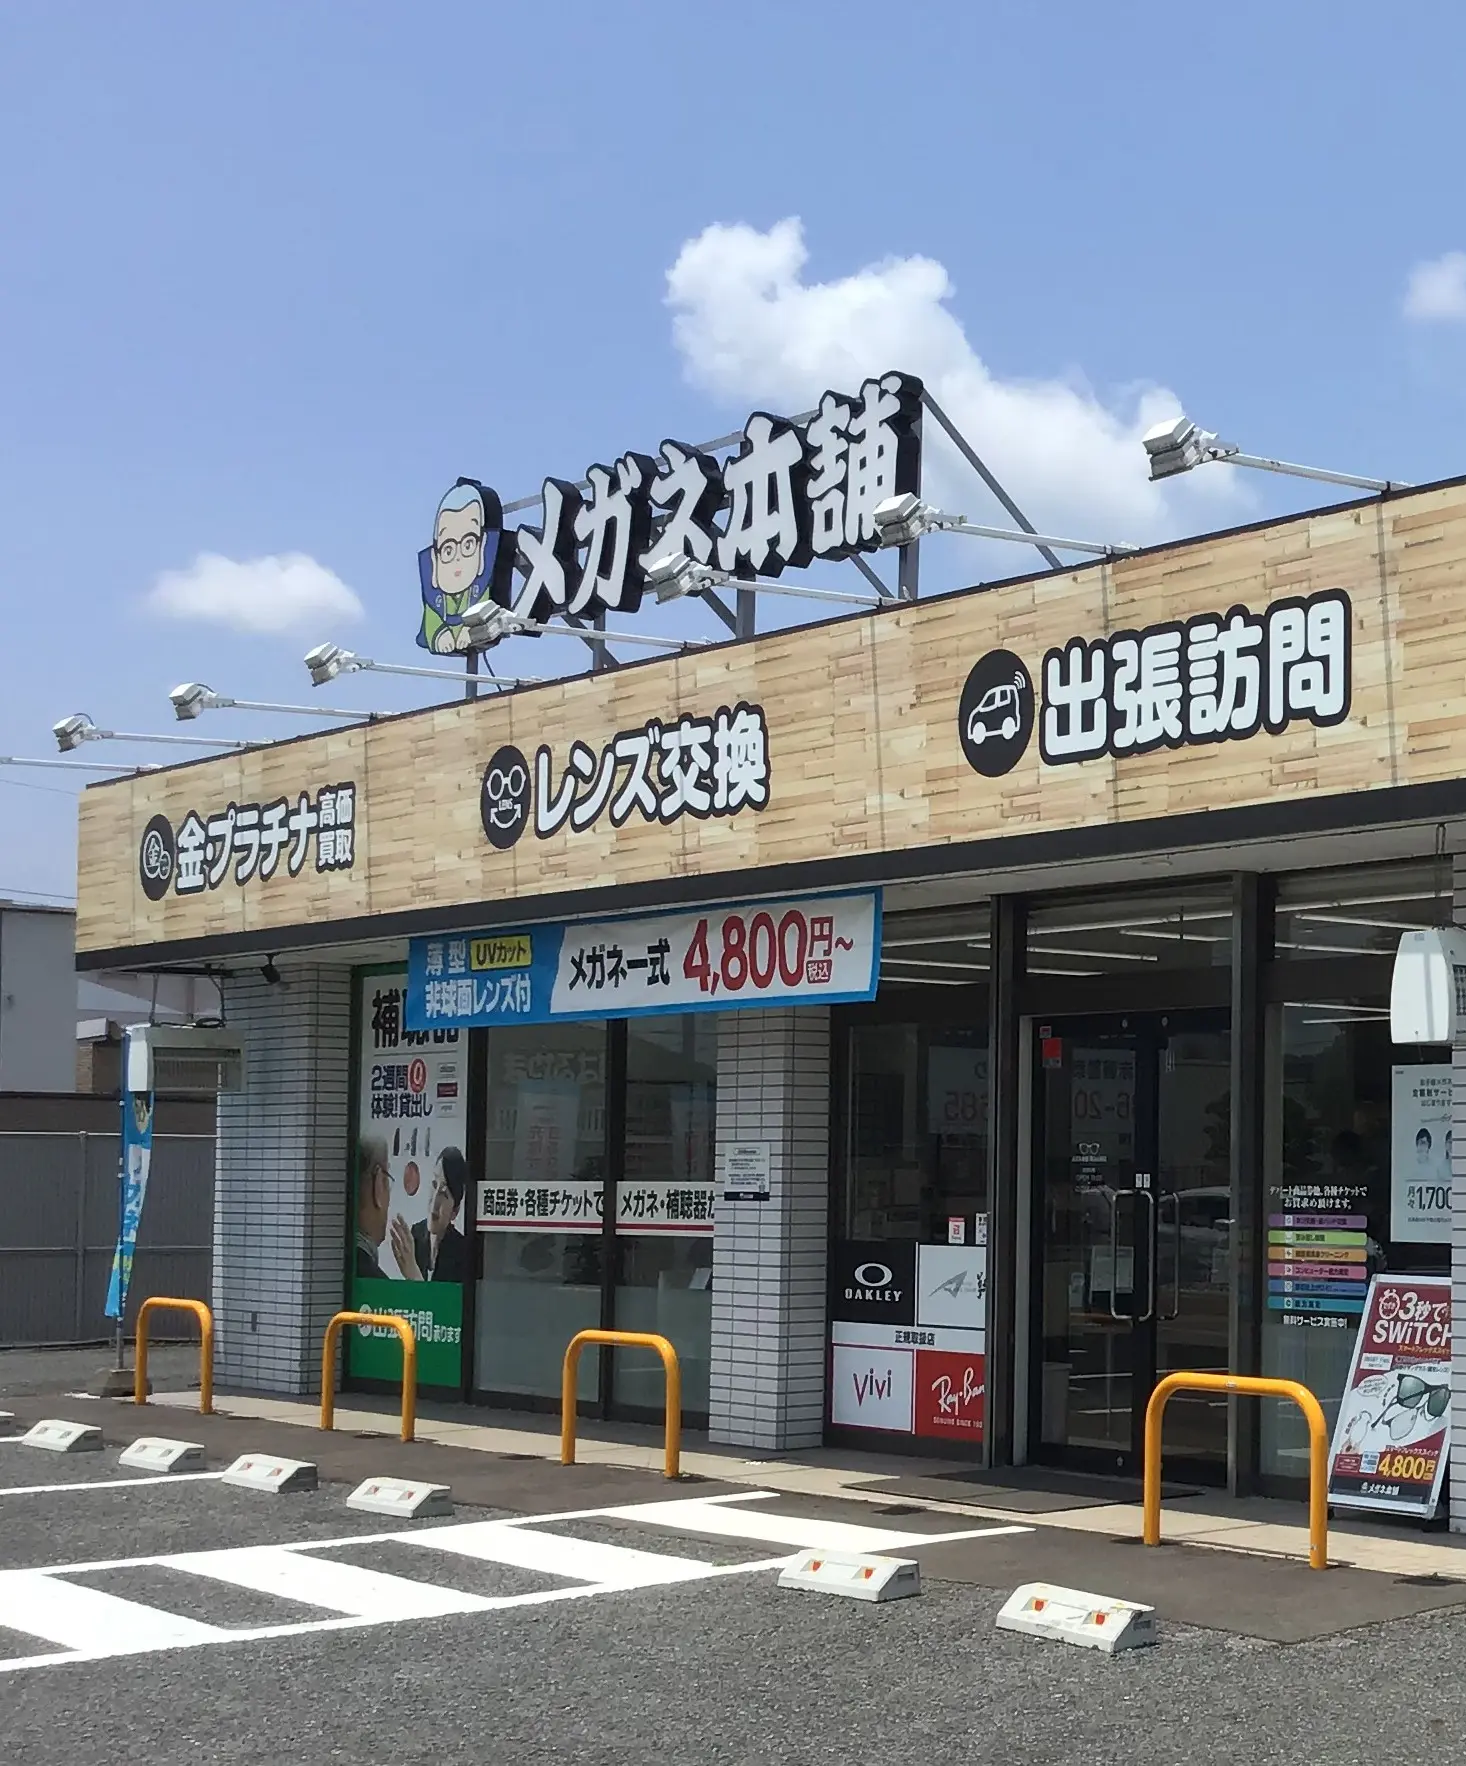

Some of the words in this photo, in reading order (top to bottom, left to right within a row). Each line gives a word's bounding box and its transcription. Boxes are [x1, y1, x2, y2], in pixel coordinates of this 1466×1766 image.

[512, 373, 902, 624] メガネ本舗
[1044, 599, 1345, 757] 出張訪問
[538, 709, 766, 833] レンズ交換
[319, 788, 354, 828] 高価
[319, 829, 354, 867] 買取
[475, 942, 528, 967] UVカット
[568, 938, 671, 991] メガネ一式
[424, 973, 532, 1019] 非球面レンズ付
[371, 1065, 409, 1091] 2週間
[844, 1288, 903, 1302] OAKLEY
[894, 1330, 935, 1346] 正規取扱店
[853, 1367, 892, 1407] Vivi
[1378, 1453, 1425, 1480] 4,800
